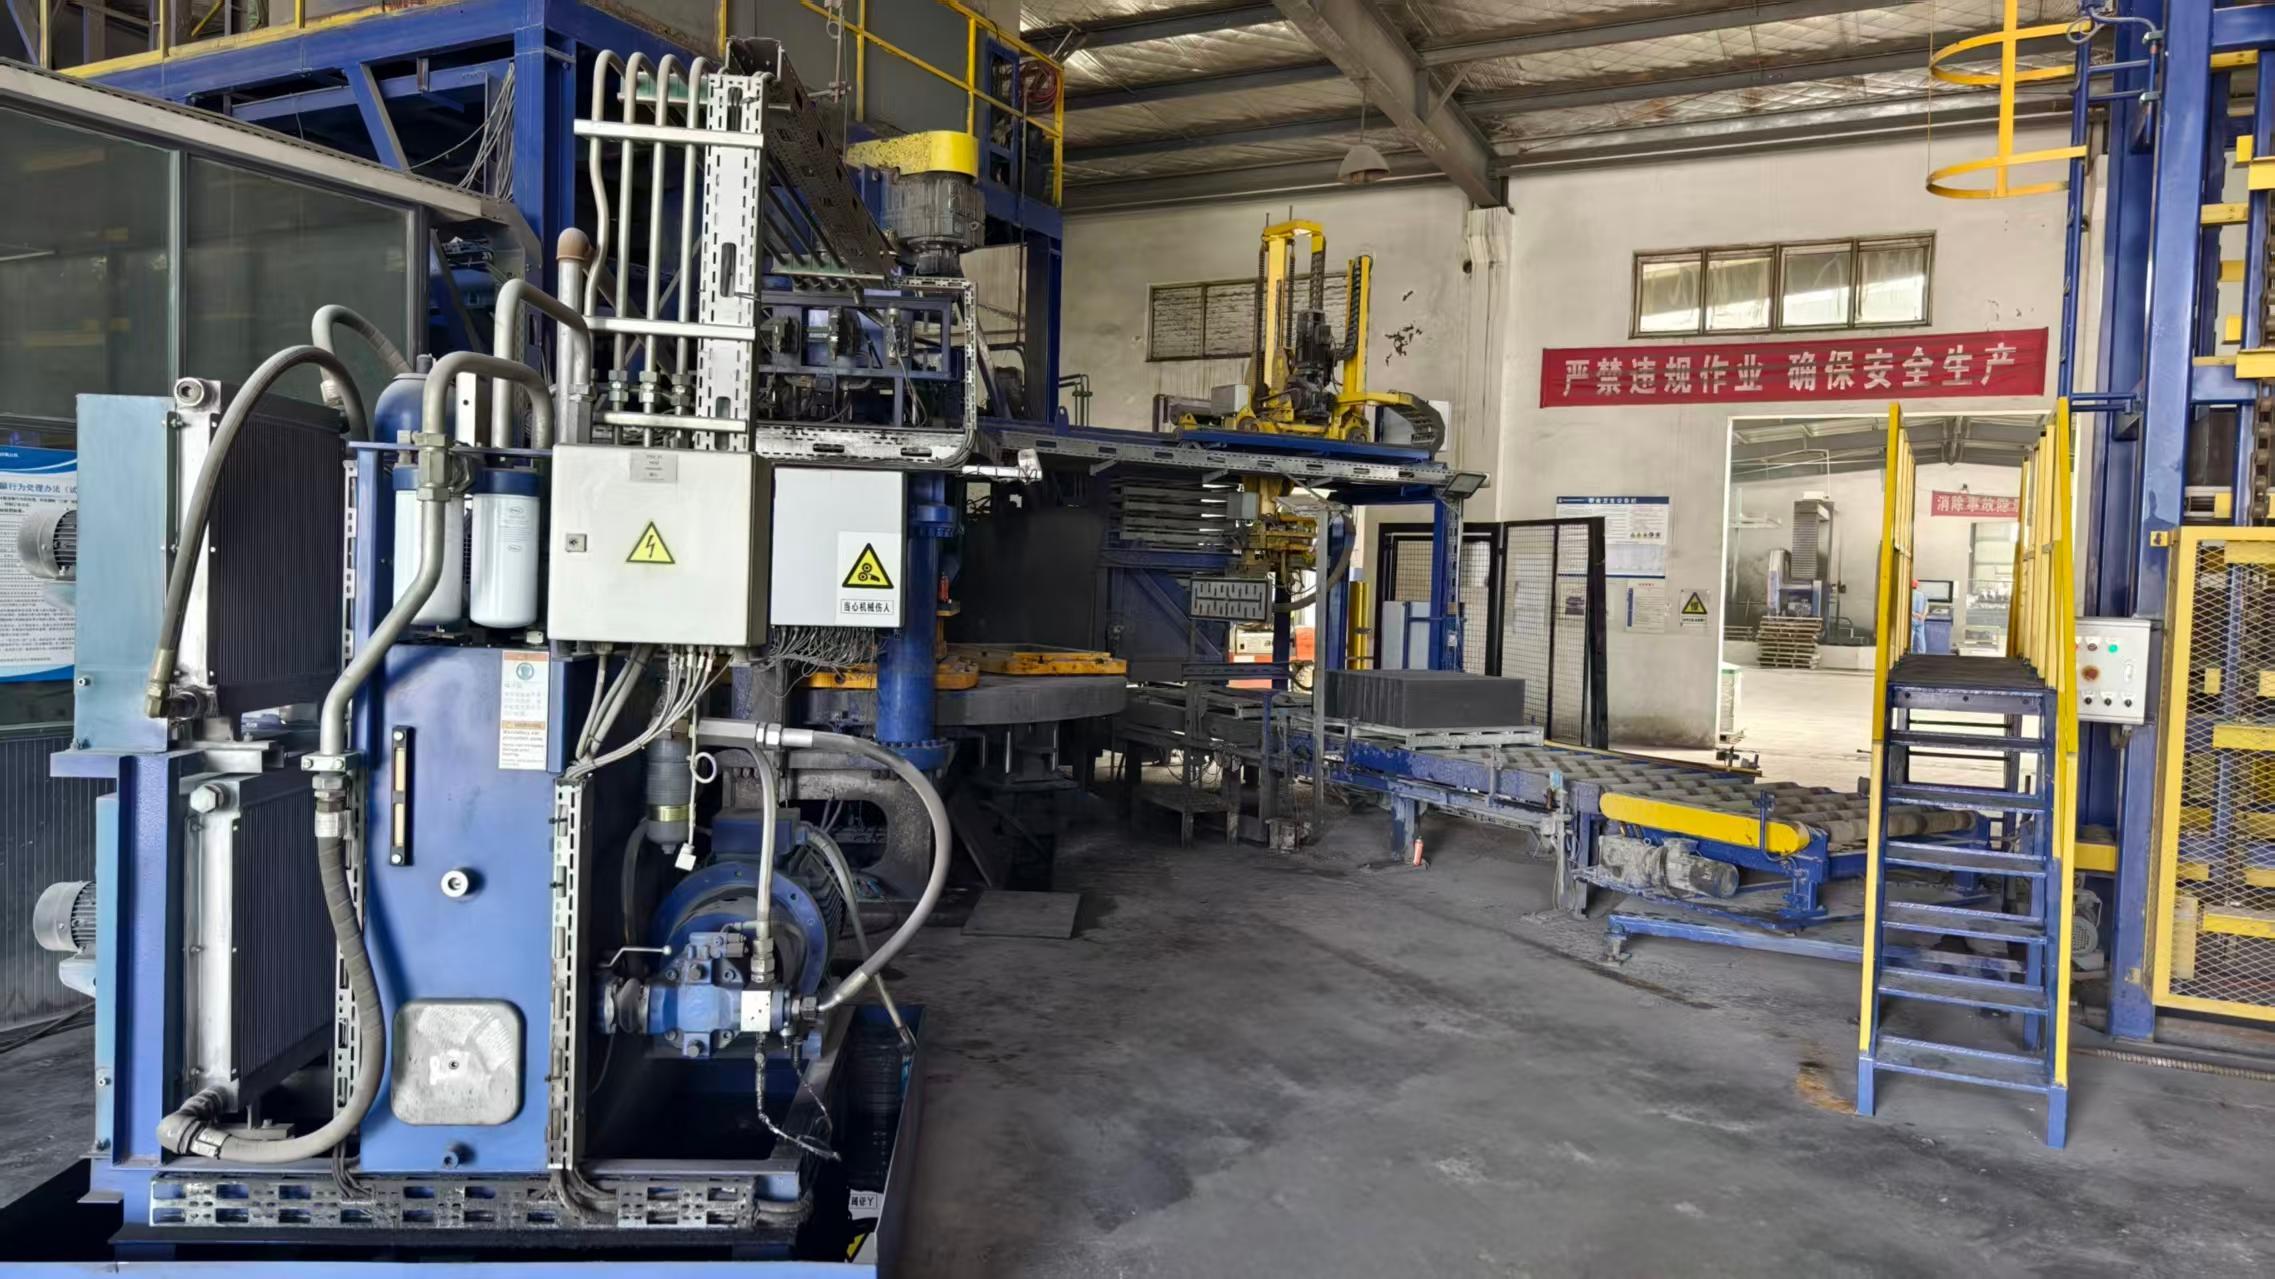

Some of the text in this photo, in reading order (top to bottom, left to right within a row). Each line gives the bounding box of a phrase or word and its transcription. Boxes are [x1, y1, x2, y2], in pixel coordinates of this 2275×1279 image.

[1563, 342, 2017, 397] 严禁违规作业 确保安全生产
[843, 602, 890, 613] 当心机械伤人
